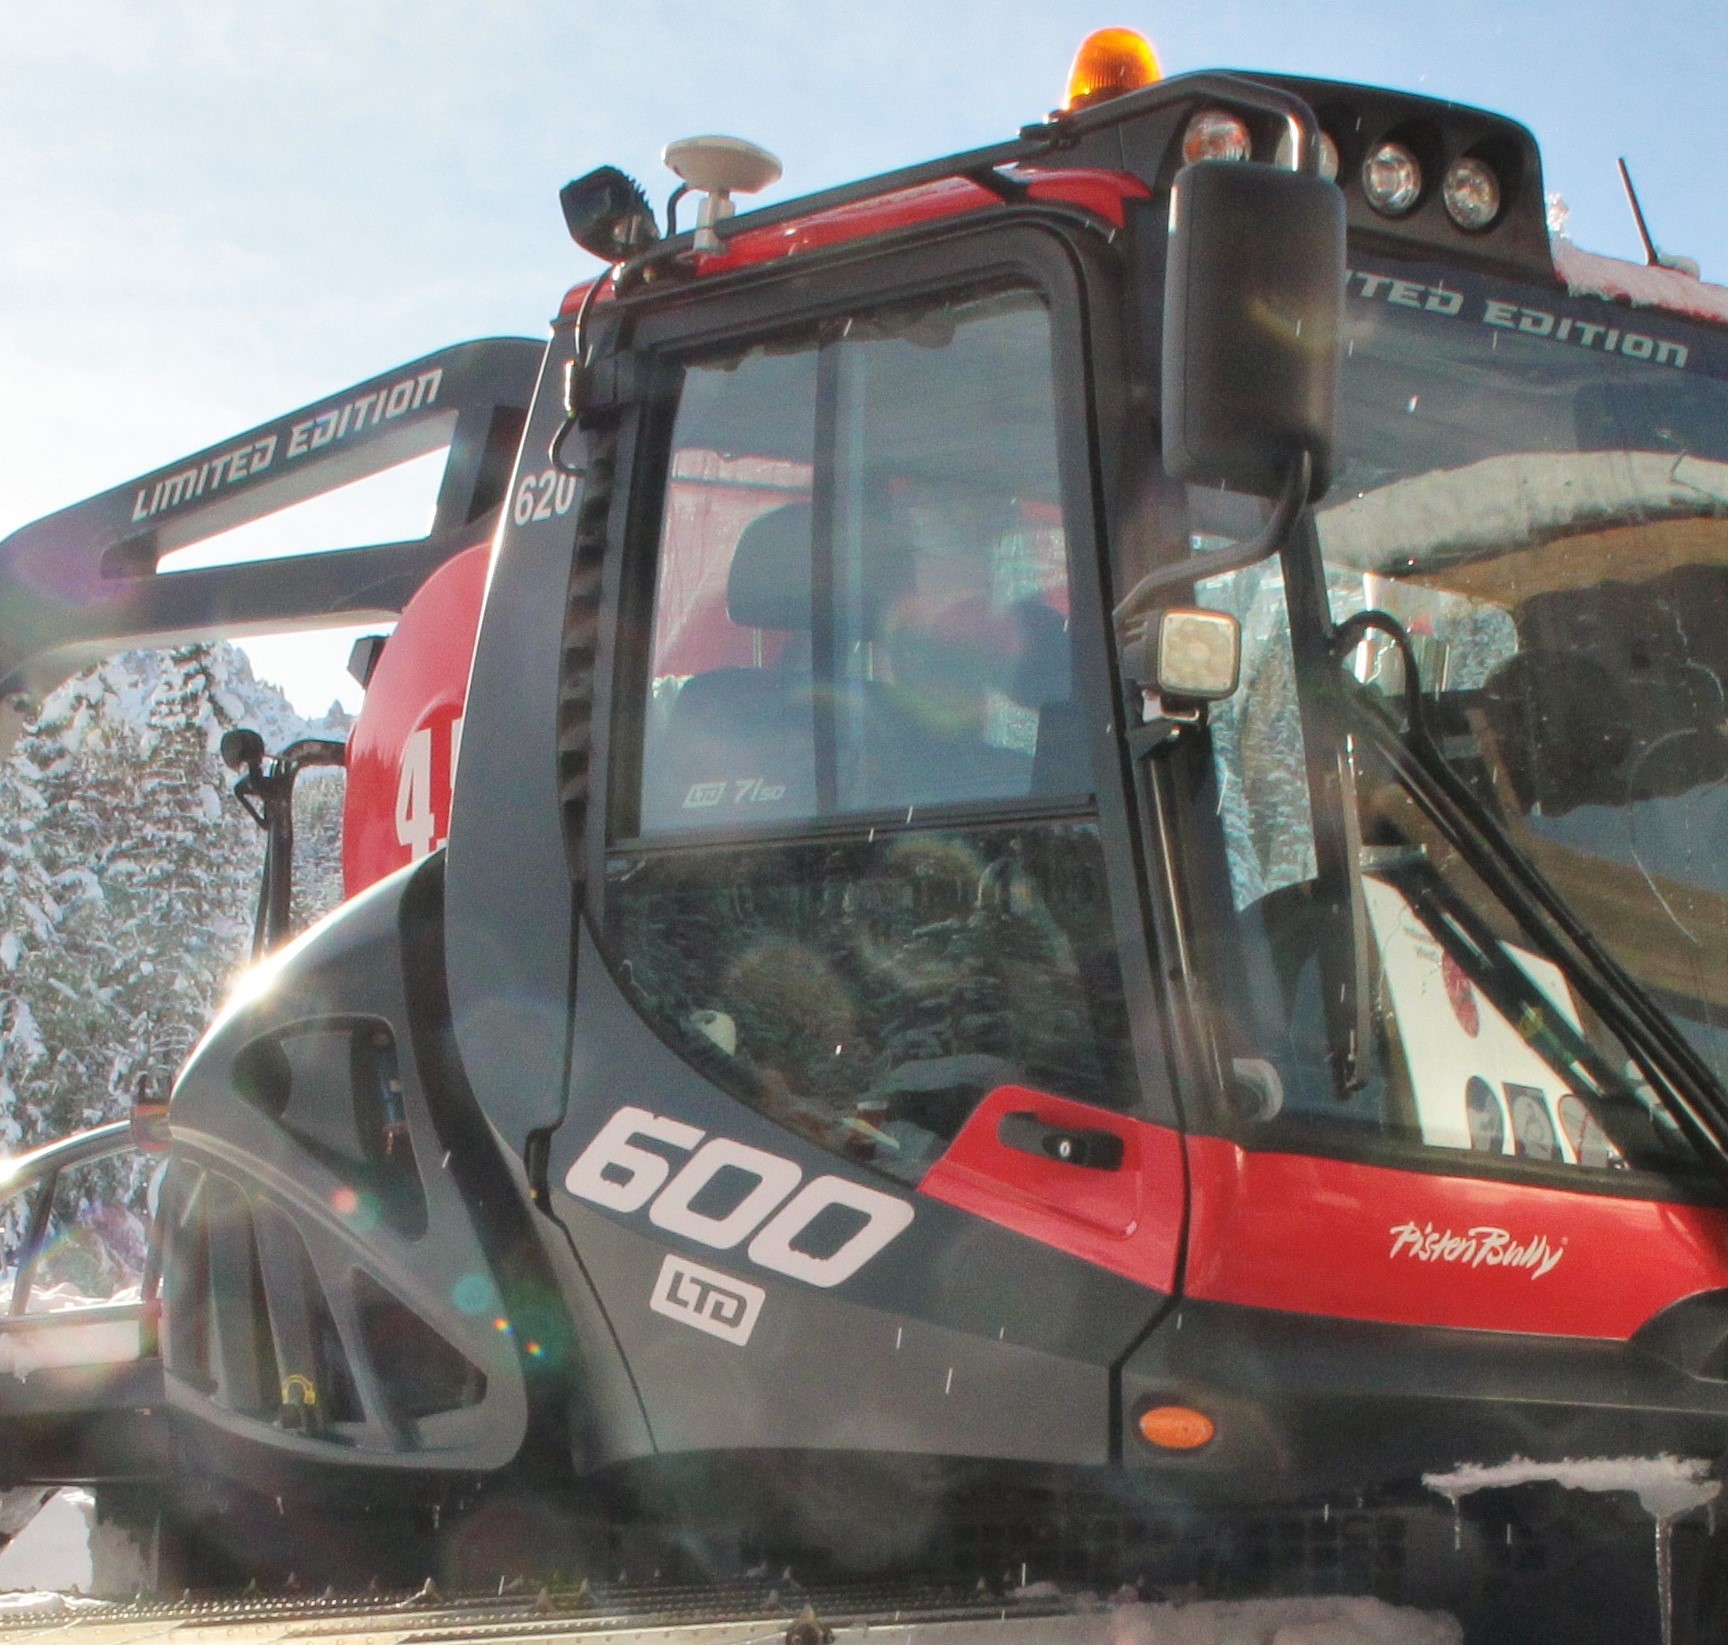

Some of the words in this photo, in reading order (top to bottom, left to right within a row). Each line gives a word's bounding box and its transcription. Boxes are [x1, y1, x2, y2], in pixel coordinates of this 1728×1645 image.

[1482, 299, 1689, 369] EDITION
[131, 434, 279, 522] LIMITED
[286, 368, 443, 458] EDITION
[514, 468, 577, 526] 620
[565, 1105, 916, 1289] 600
[665, 1270, 748, 1330] LTD
